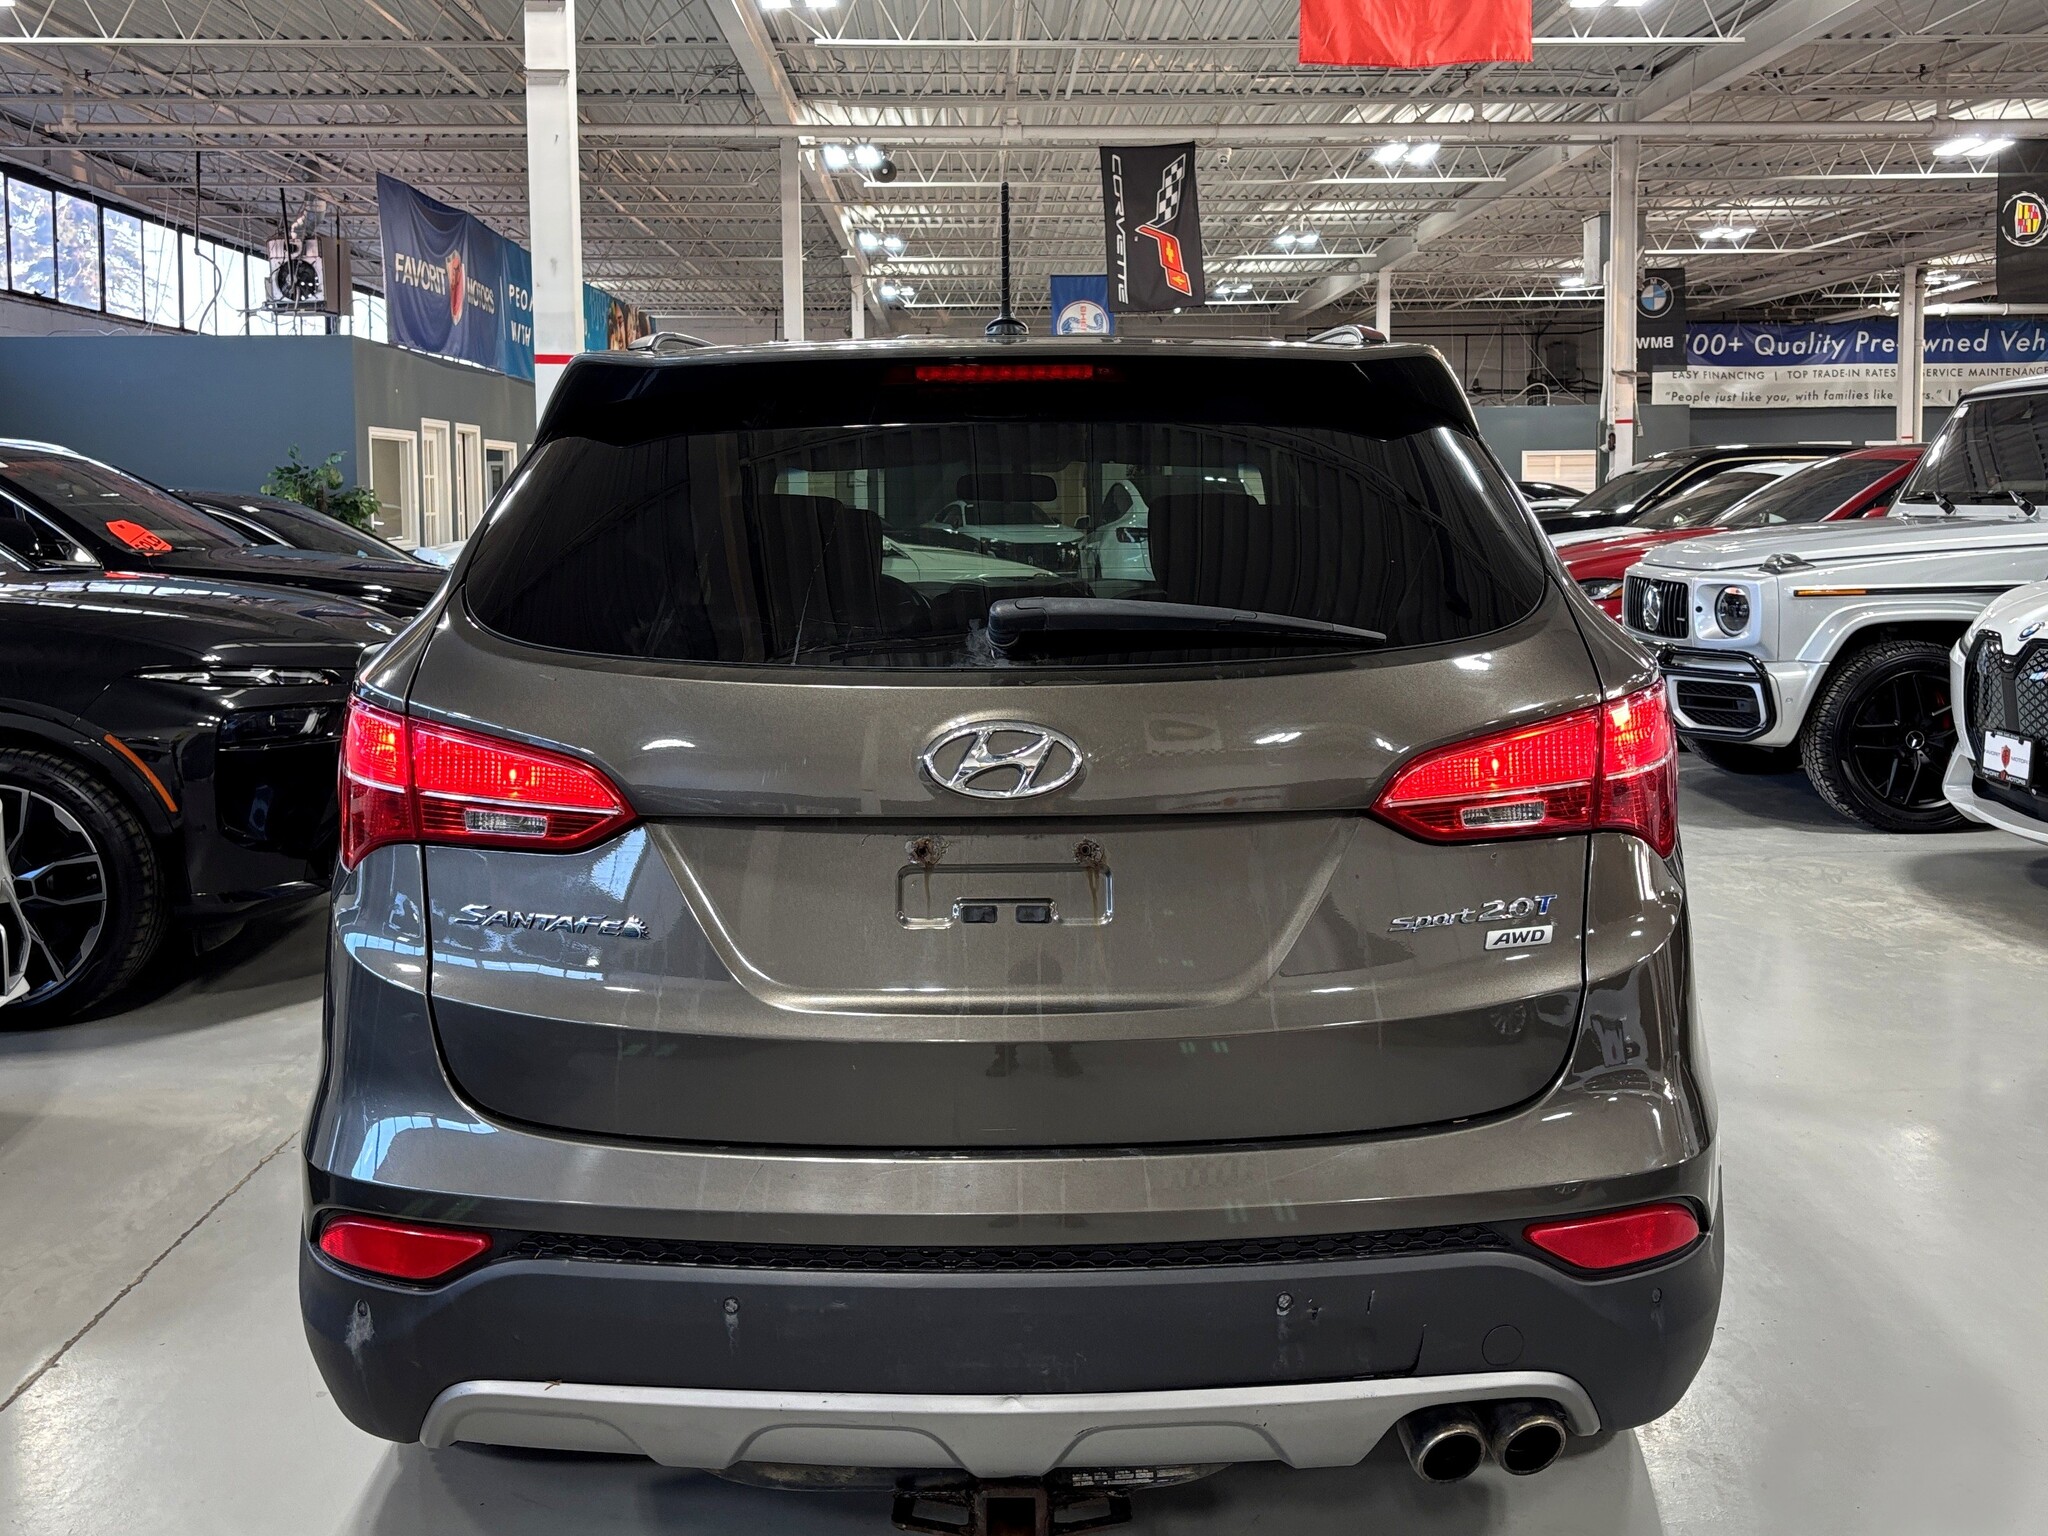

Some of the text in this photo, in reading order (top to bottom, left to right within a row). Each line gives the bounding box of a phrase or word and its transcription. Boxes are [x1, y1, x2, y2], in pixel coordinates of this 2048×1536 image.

[1112, 154, 1129, 304] CORVETTE
[395, 253, 495, 314] FAVORIT MOTORS
[510, 320, 531, 347] WITH
[1754, 332, 1846, 360] Quality
[1672, 370, 1699, 380] EASY
[1703, 371, 1765, 380] FINANCING
[1787, 370, 1809, 379] TOP
[1813, 368, 1861, 378] TRADE-IN
[1865, 368, 1897, 377] RATES
[1716, 391, 1737, 402] just
[1741, 391, 1762, 402] like
[1766, 392, 1790, 404] you,
[1795, 390, 1818, 401] with
[1824, 388, 1870, 400] families
[1873, 388, 1893, 400] like
[1492, 929, 1546, 946] AWD
